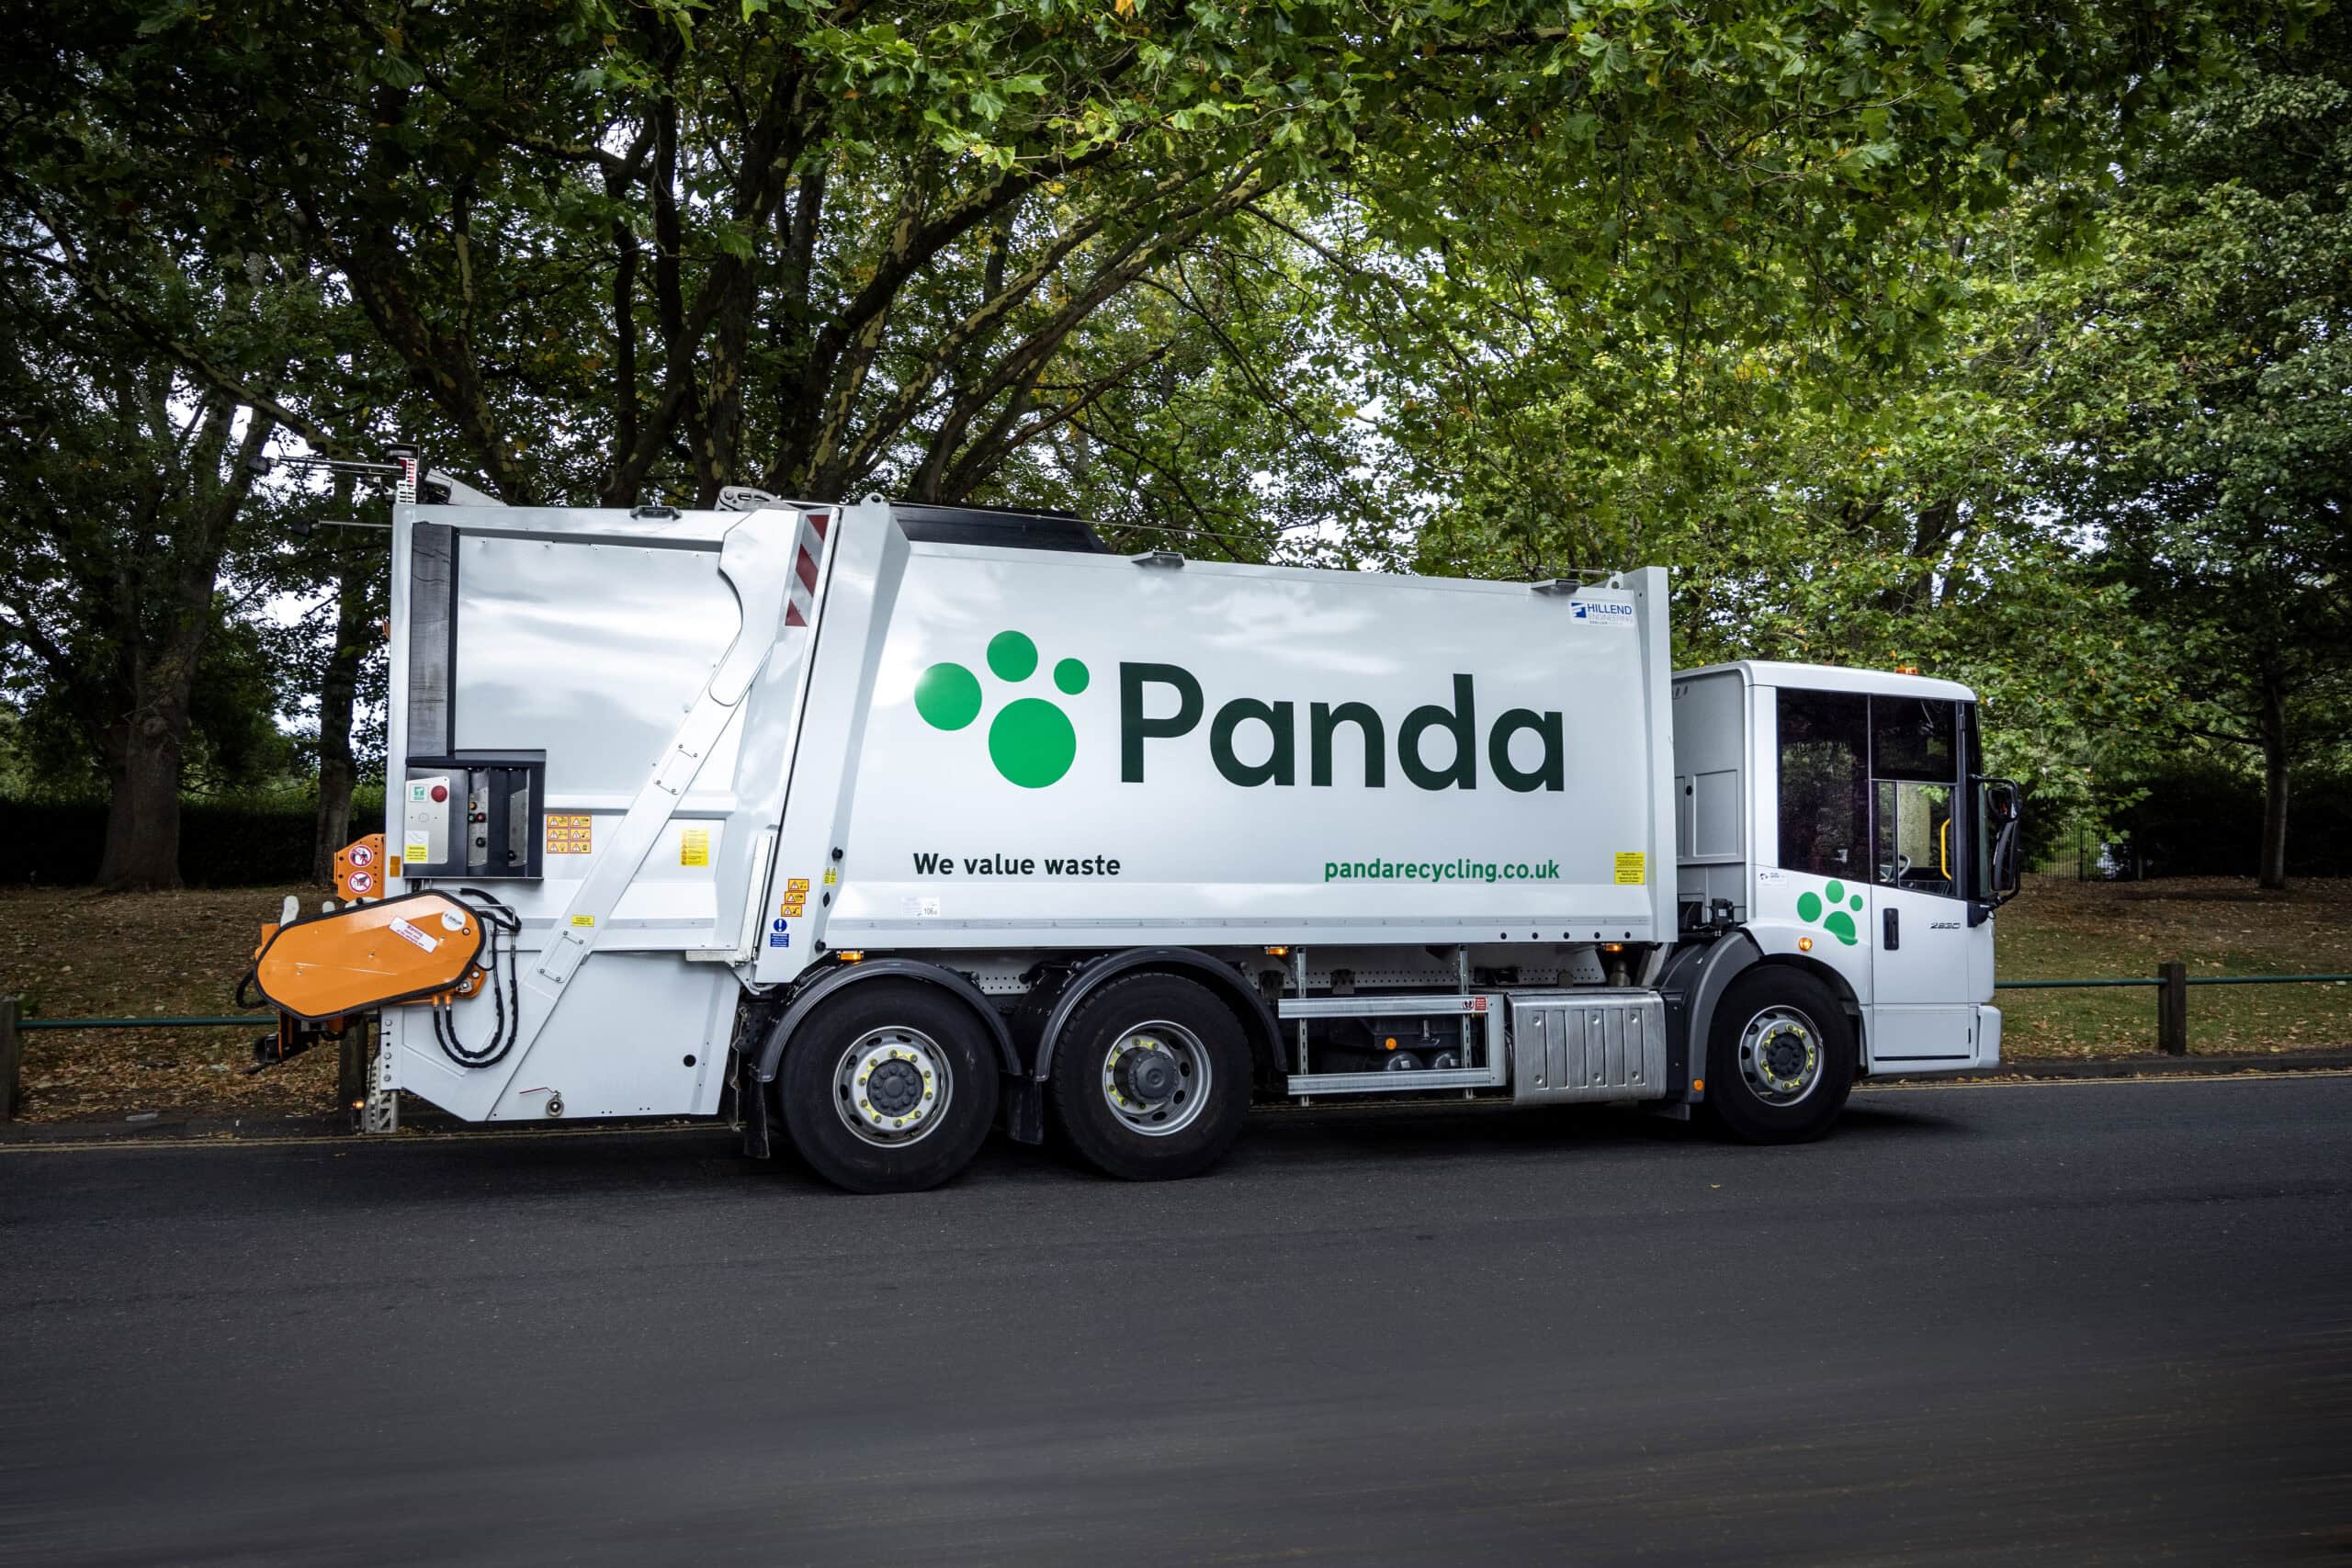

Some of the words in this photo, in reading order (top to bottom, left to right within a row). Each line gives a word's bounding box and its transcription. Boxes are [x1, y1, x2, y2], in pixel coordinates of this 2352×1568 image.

[1587, 603, 1633, 615] HILLEND
[1119, 661, 1565, 793] Panda
[913, 852, 955, 875] We
[964, 852, 1035, 875] value
[1044, 854, 1121, 875] waste
[1324, 857, 1560, 883] pandarecycling.co.uk
